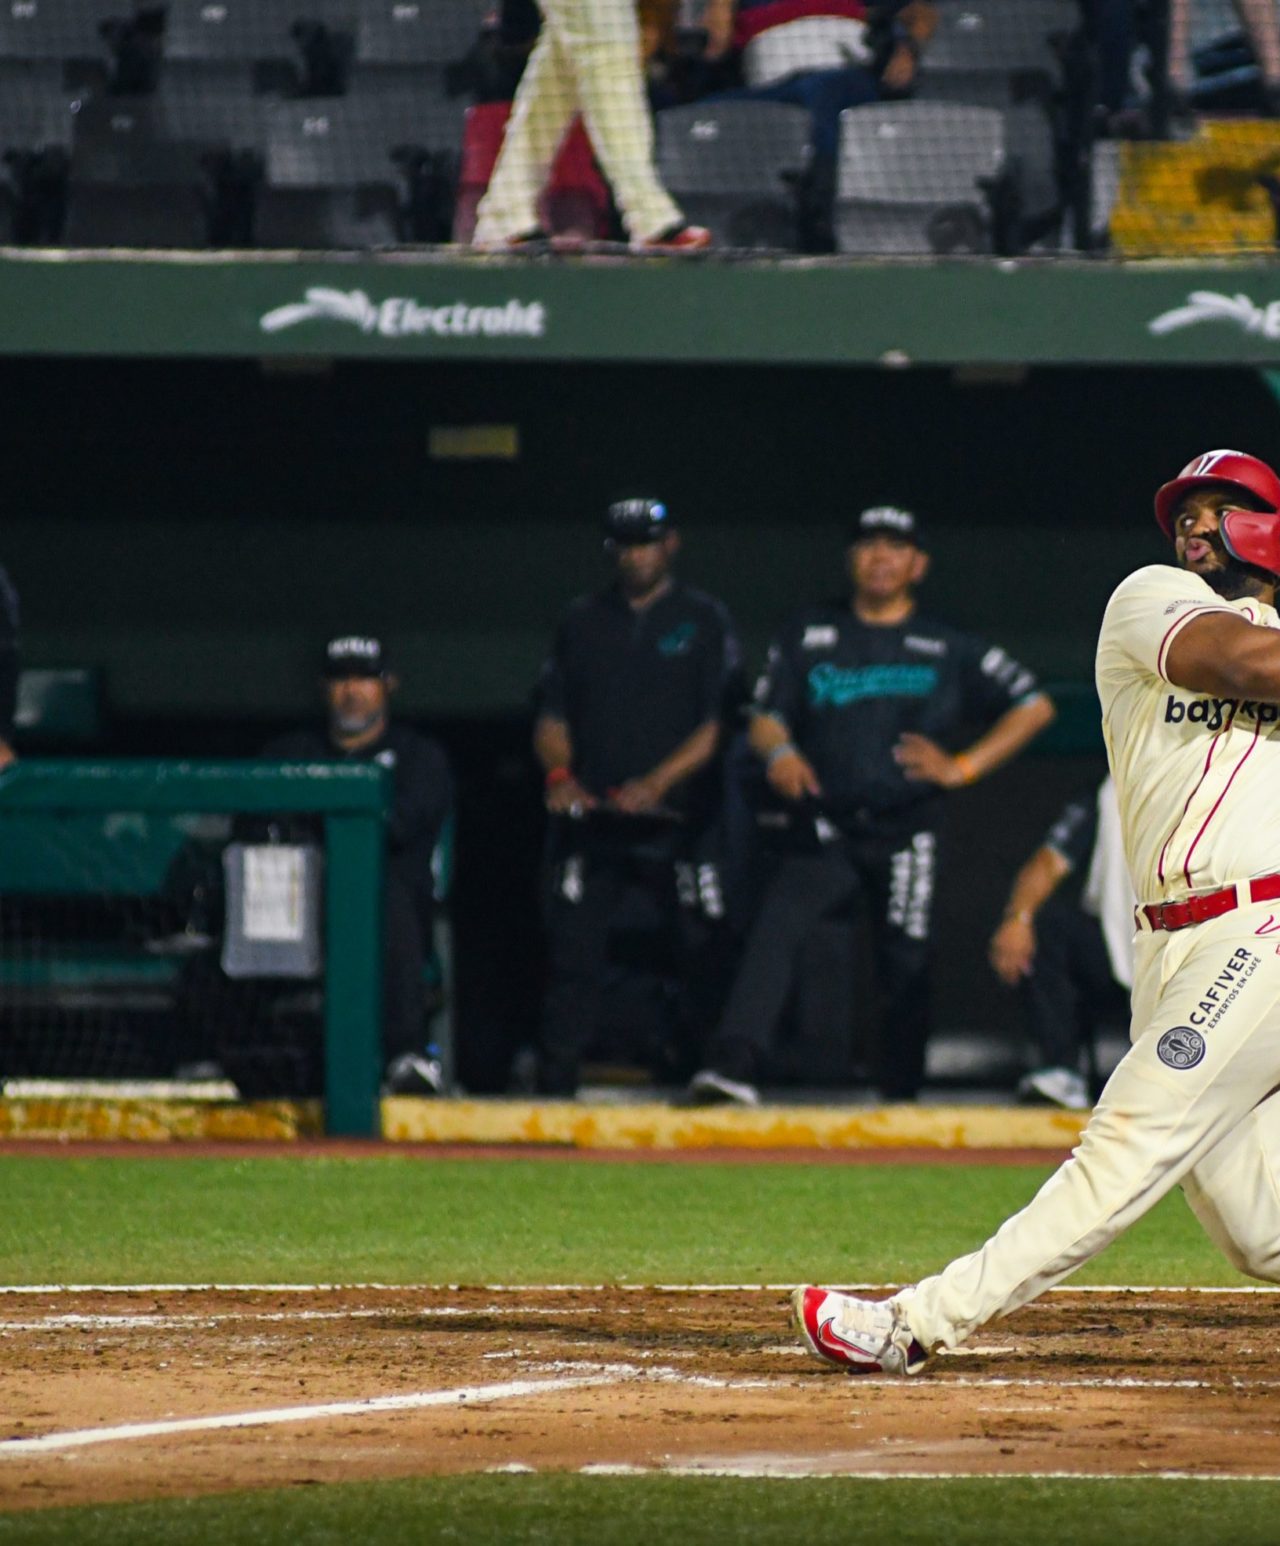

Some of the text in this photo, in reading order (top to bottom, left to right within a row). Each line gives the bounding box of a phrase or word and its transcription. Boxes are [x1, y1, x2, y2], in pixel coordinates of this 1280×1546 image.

[1189, 947, 1252, 1025] CAFIVER
[1207, 988, 1239, 1029] EXPERTOS
[1236, 977, 1248, 989] EN
